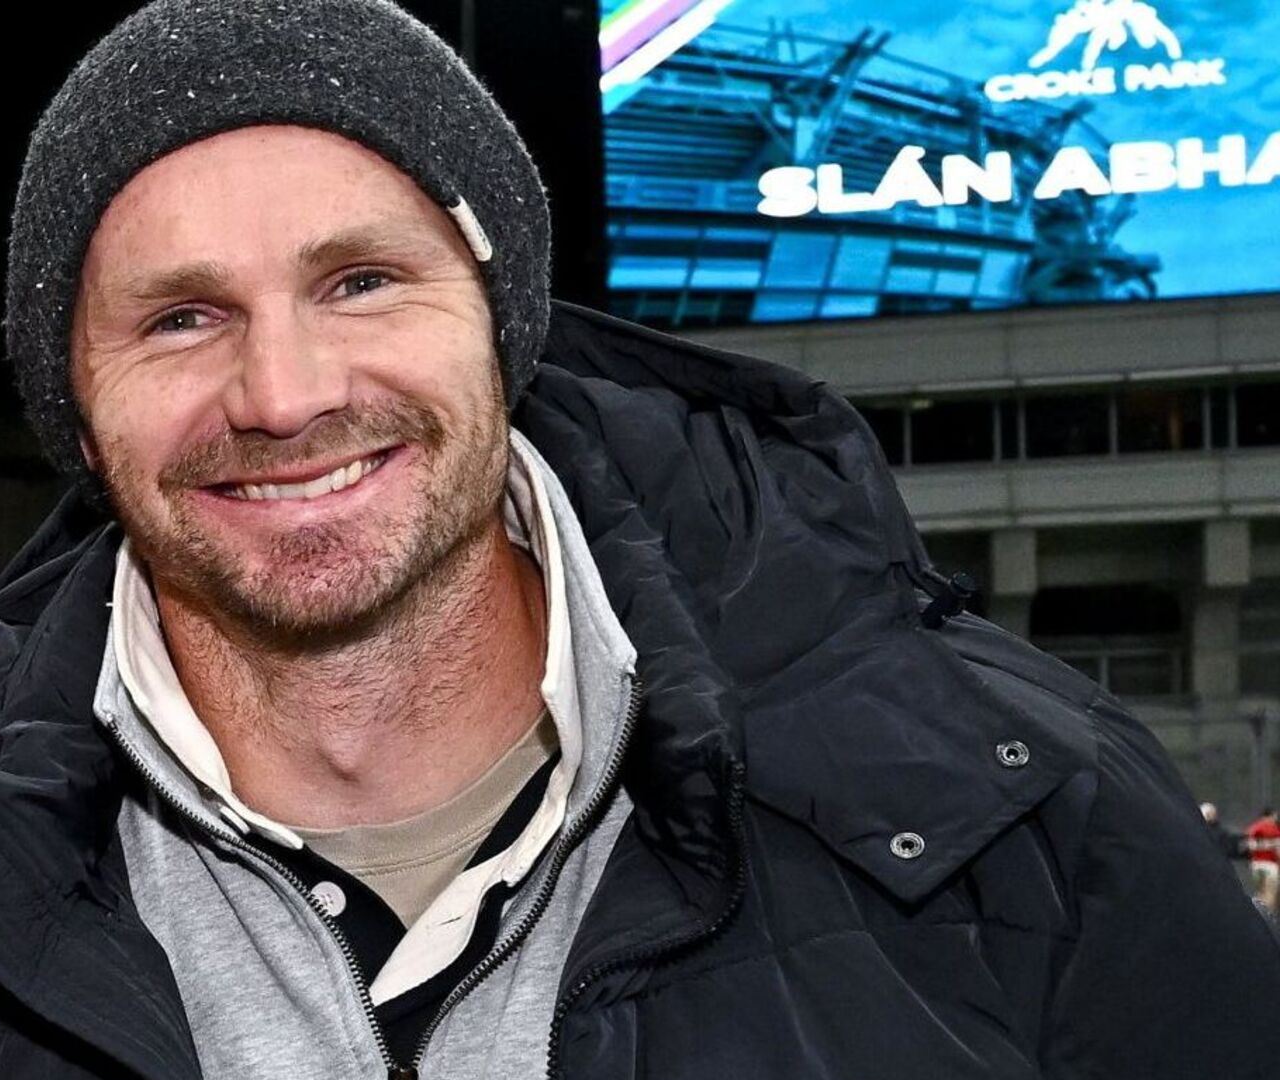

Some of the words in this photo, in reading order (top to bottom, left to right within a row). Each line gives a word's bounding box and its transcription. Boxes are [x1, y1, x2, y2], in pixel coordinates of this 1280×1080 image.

[985, 68, 1115, 102] CROKE
[1125, 59, 1225, 91] PARK
[757, 146, 1012, 217] SLÁN
